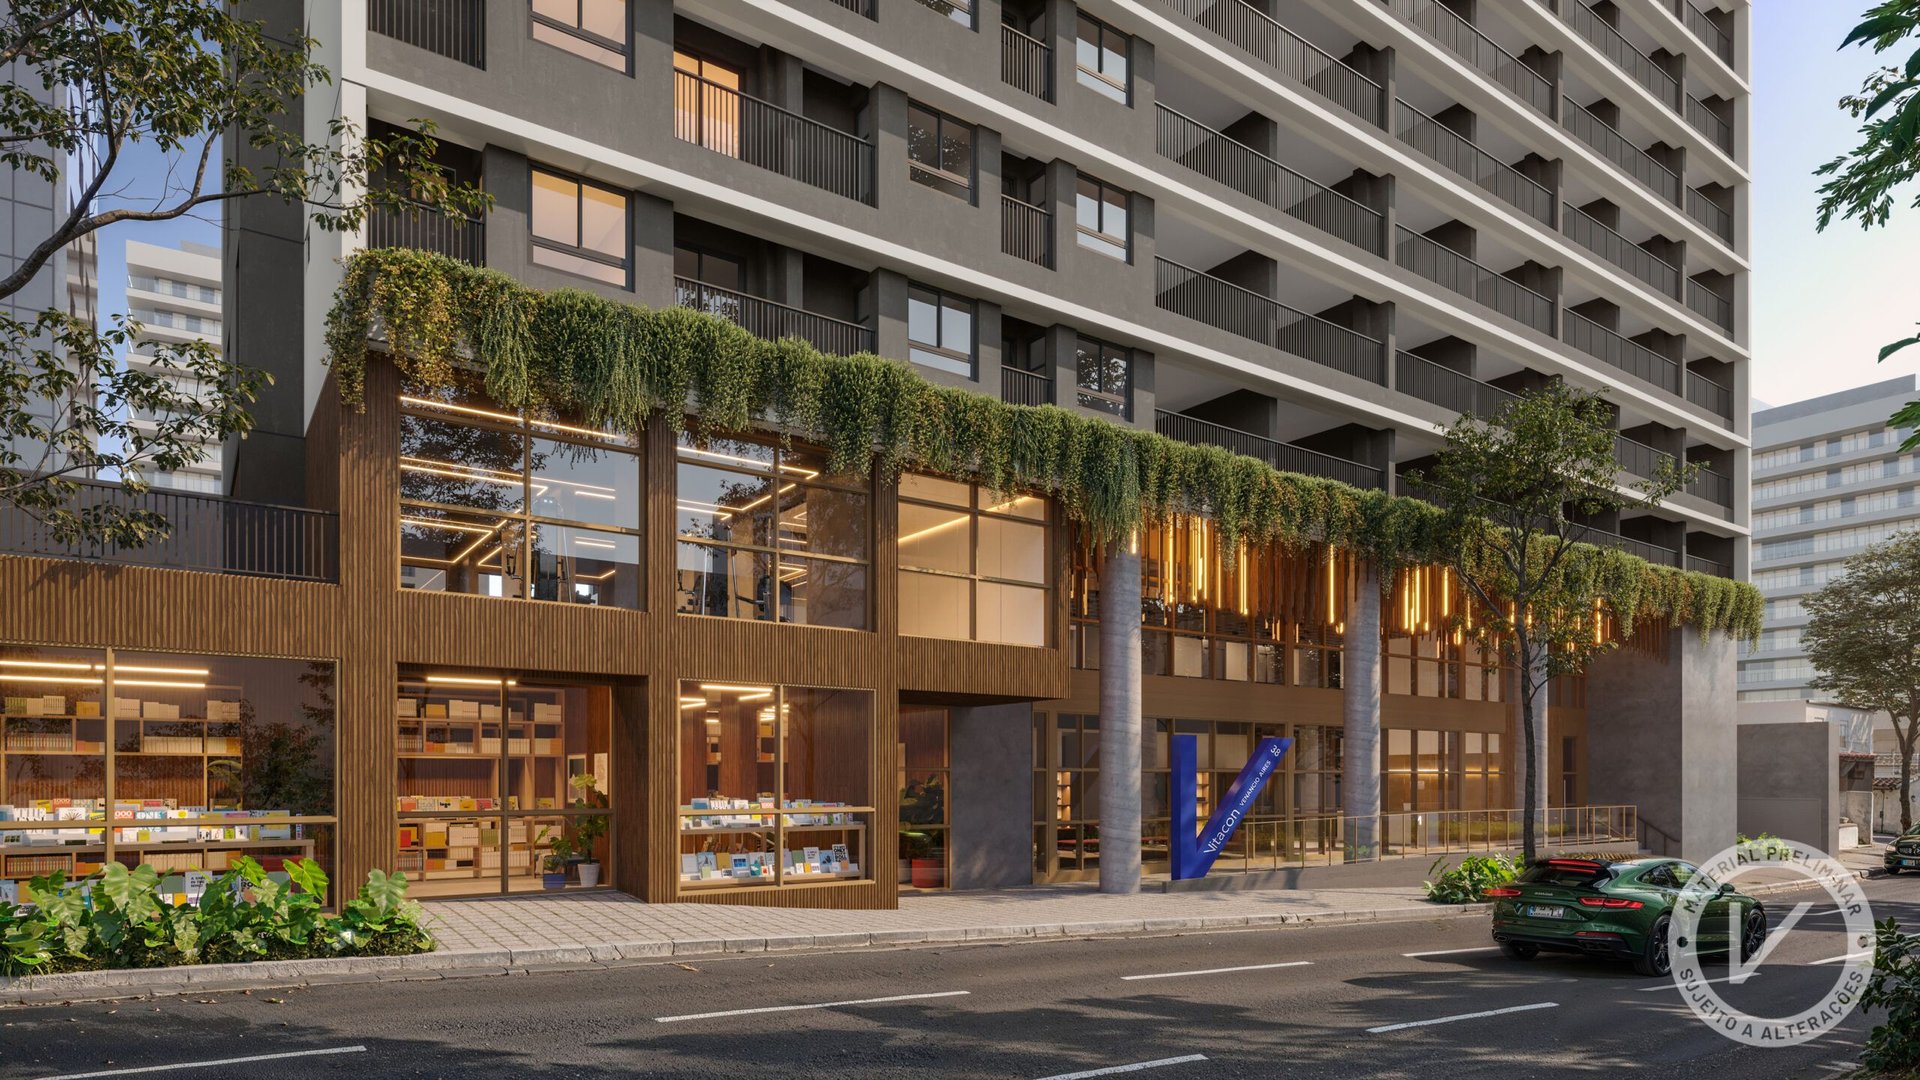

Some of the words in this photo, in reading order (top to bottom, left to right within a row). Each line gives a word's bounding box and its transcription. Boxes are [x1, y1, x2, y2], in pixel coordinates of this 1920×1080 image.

[1270, 744, 1281, 757] 38
[1203, 809, 1241, 853] Vitacon
[1239, 777, 1260, 806] VENANCIO
[1259, 760, 1271, 777] AIRES
